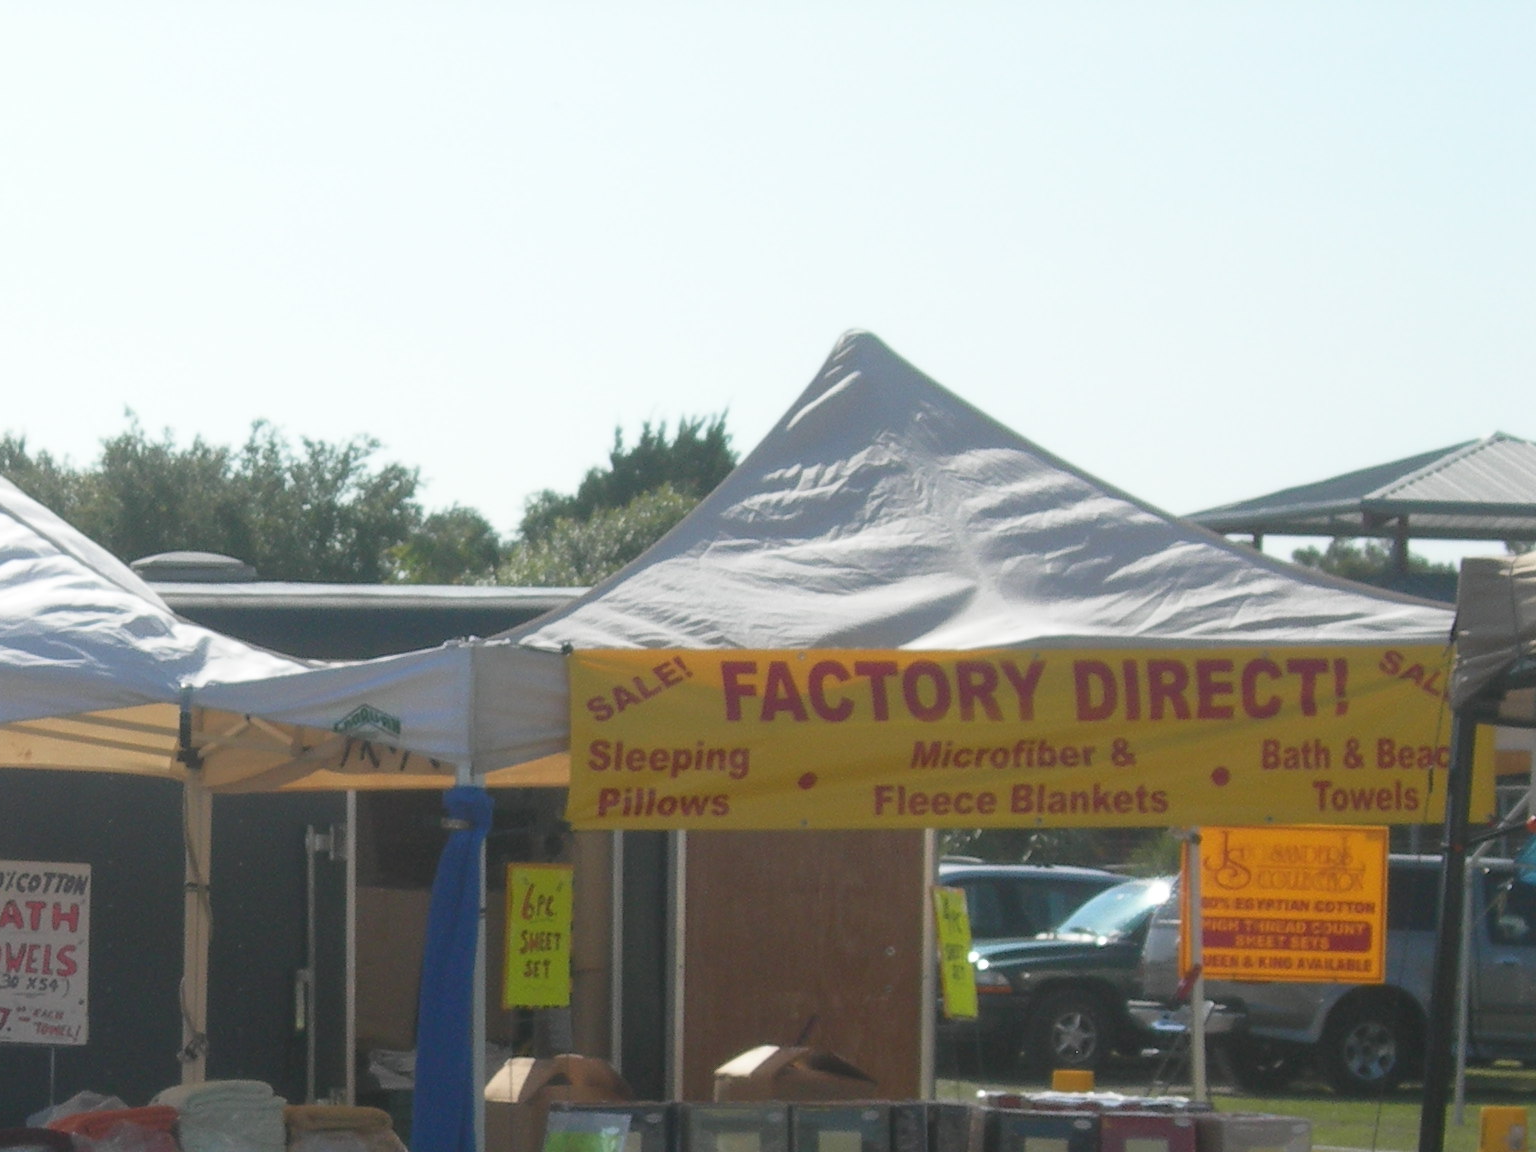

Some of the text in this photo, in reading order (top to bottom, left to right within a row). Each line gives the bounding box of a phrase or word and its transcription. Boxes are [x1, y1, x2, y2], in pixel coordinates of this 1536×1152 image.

[587, 656, 693, 721] SALE!
[721, 657, 1349, 722] FACTORY DIRECT!
[1379, 651, 1450, 699] SAL
[587, 740, 750, 780] Sleeping
[910, 737, 1136, 769] Microfiber &
[1261, 737, 1450, 769] Bath & Beac
[597, 787, 730, 818] Pillows
[874, 783, 1169, 816] Fleece Blankets
[1313, 780, 1418, 812] Towels
[16, 872, 88, 895] COTTON
[1235, 898, 1309, 912] EGYPTIAN
[1314, 900, 1375, 914] COTTON
[1235, 935, 1329, 949] SHEET SETS
[1244, 919, 1306, 933] THREAD
[1311, 922, 1363, 935] COUNT
[1203, 954, 1371, 972] UEEN & KING AVAILABLE
